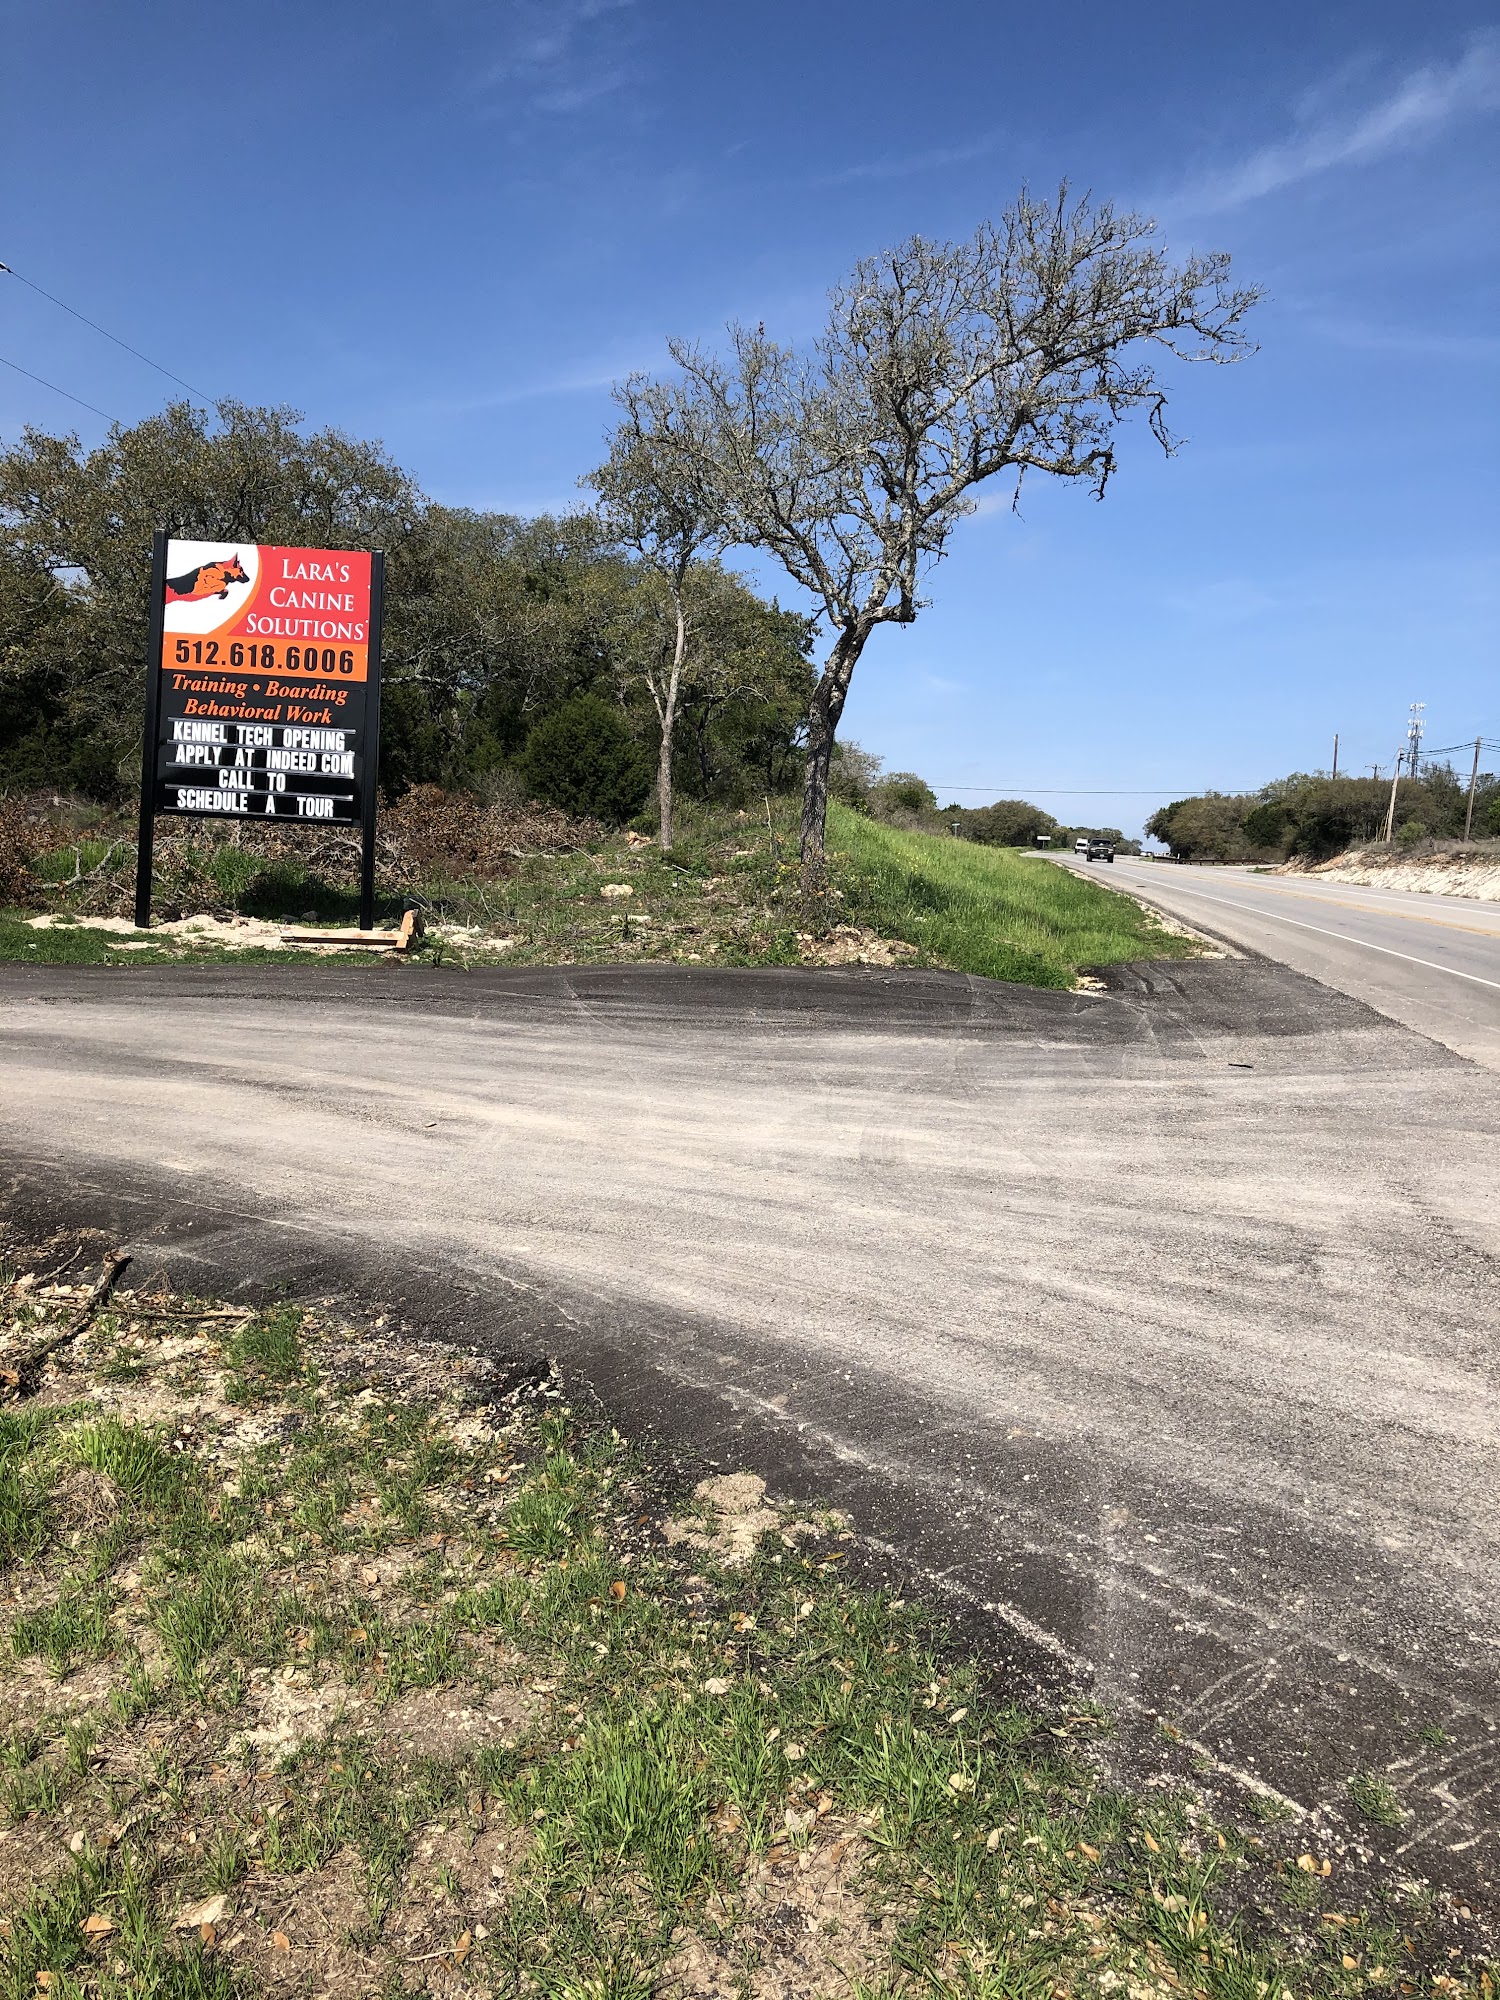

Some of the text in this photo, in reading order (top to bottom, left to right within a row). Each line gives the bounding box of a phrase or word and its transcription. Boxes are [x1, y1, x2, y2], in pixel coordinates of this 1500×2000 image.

[176, 640, 353, 673] 512.618.6006
[172, 674, 348, 706] Training Boarding
[183, 698, 332, 724] Behavioral Work
[173, 721, 345, 751] KENNEL TECH OPENING
[176, 744, 353, 774] APPLY AT INDEED COM
[219, 769, 286, 792] CALL TO
[177, 789, 334, 817] SCHEDULE A TOUR
